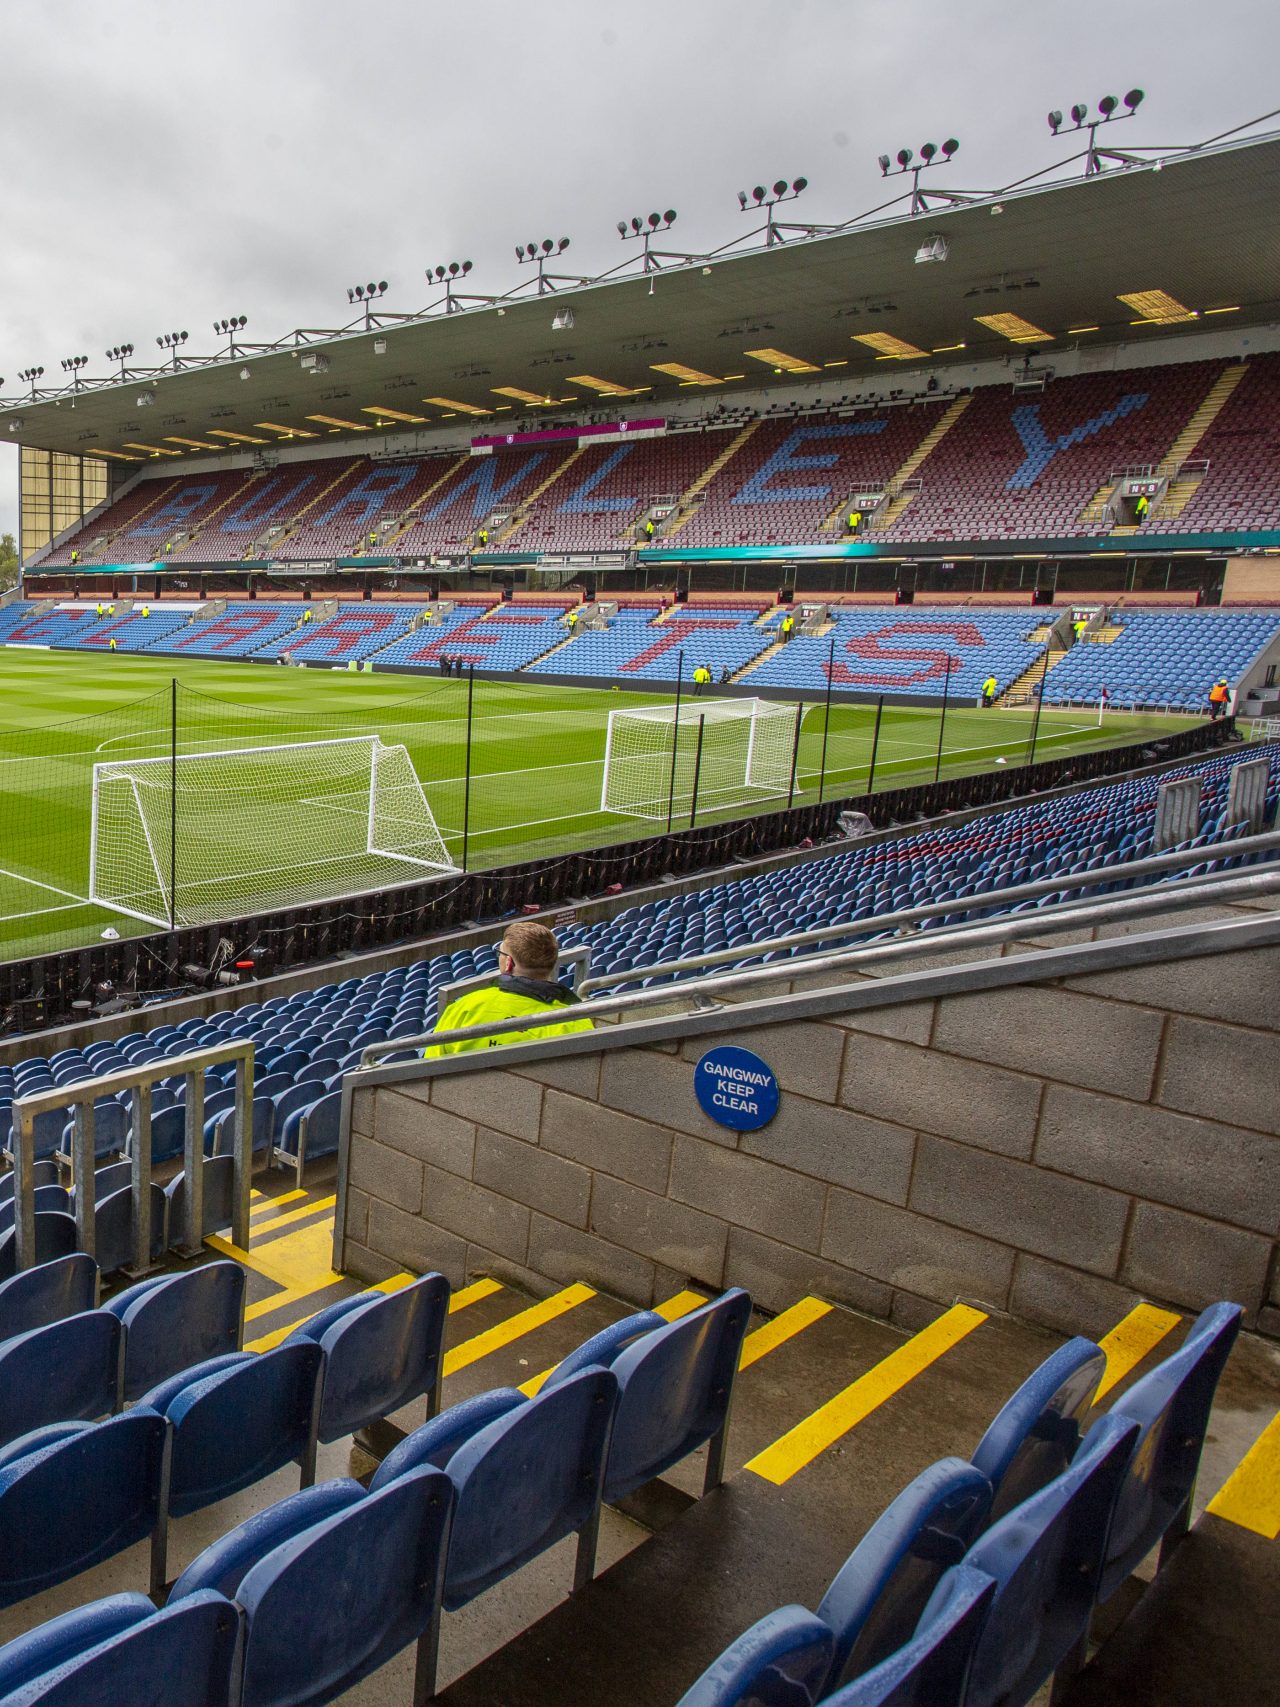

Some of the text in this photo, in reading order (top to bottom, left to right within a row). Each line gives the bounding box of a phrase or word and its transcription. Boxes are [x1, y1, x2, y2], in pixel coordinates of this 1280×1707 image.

[704, 1062, 771, 1087] GANGWAY
[718, 1080, 754, 1097] KEEP
[712, 1094, 758, 1115] CLEAR
